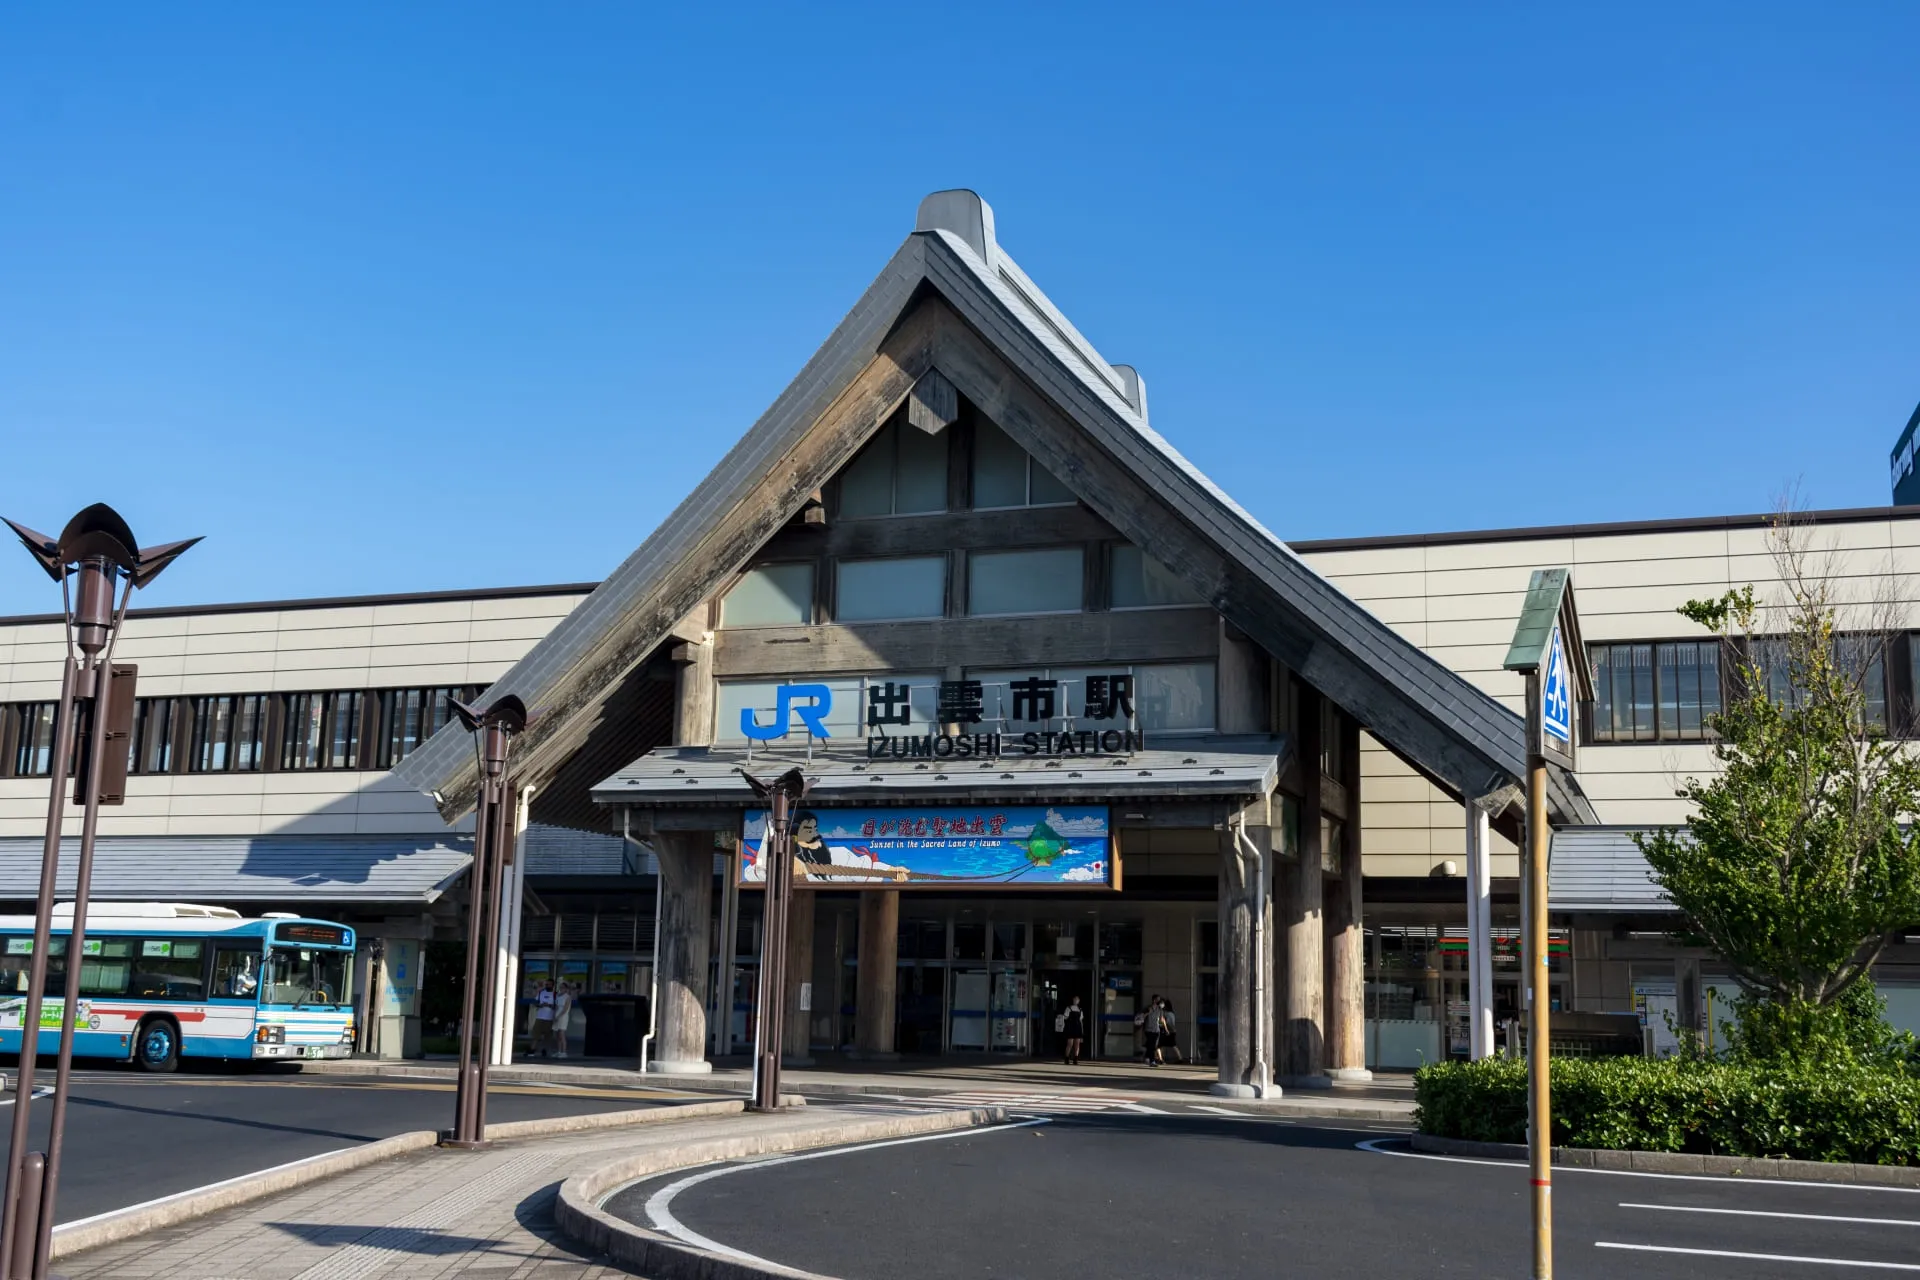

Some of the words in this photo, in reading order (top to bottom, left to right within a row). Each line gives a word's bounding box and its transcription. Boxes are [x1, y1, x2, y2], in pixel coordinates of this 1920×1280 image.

[740, 684, 832, 740] JR
[868, 675, 1135, 727] 出雲市駅
[867, 734, 1001, 758] IZUMOSHI
[1022, 728, 1144, 755] STATION
[863, 814, 1007, 837] 日が沈む聖地出雲
[869, 840, 894, 849] Sunset
[896, 840, 905, 849] in
[907, 840, 918, 848] the
[920, 839, 946, 848] Sacred
[948, 839, 967, 848] Land
[969, 839, 977, 848] of
[979, 838, 1001, 847] Izumo
